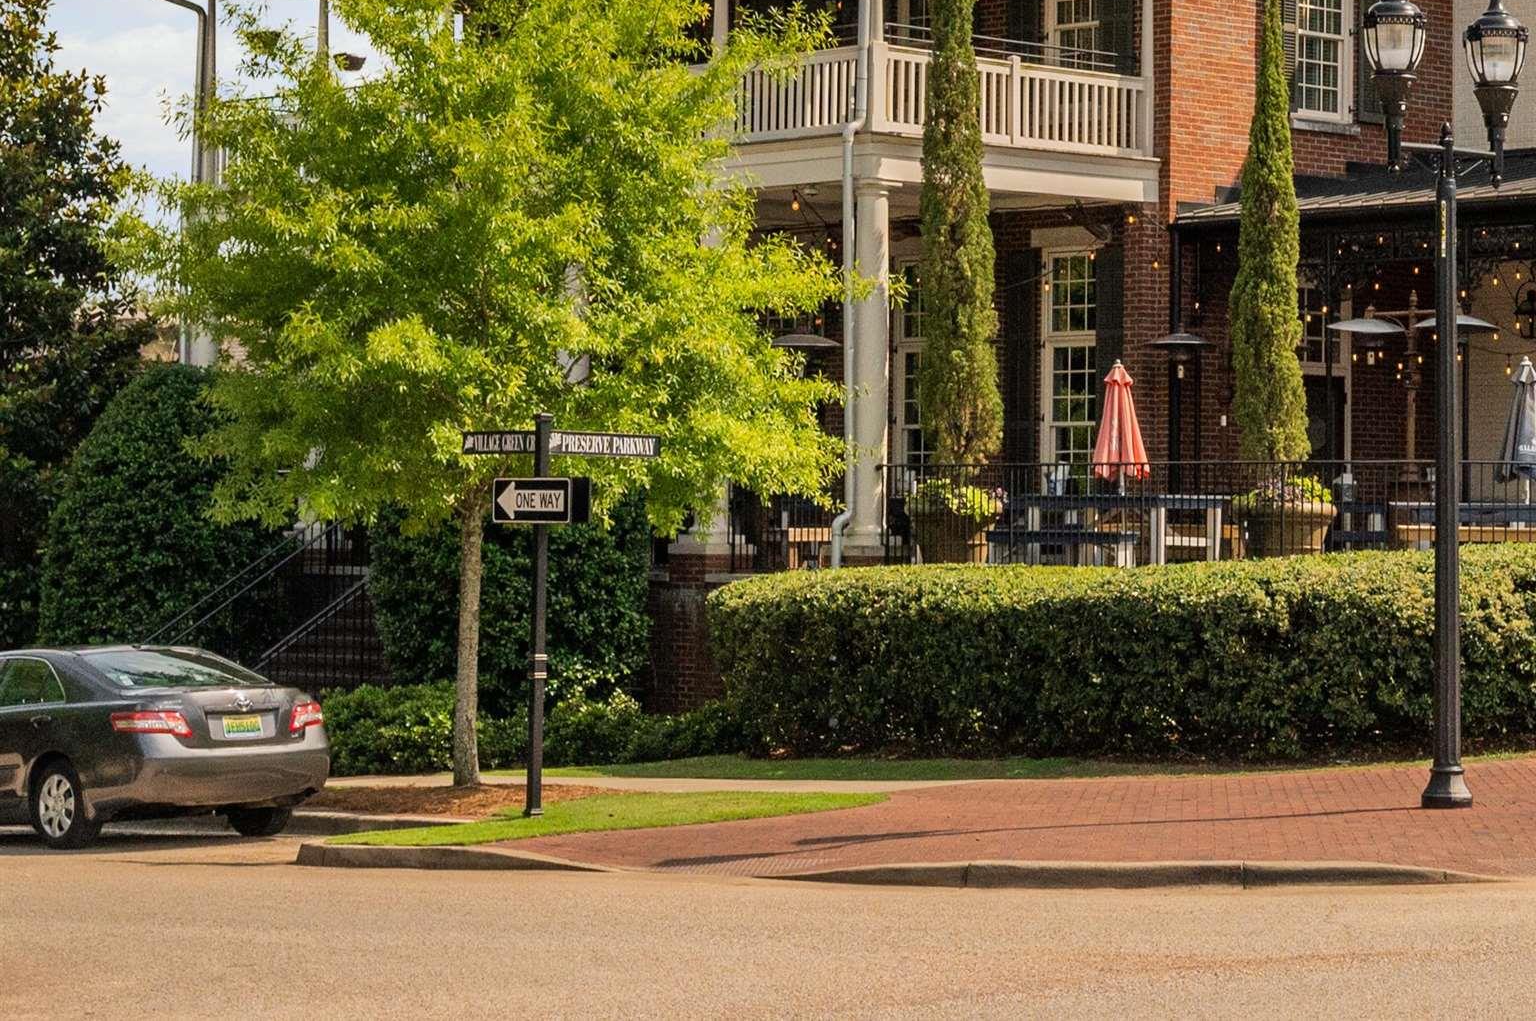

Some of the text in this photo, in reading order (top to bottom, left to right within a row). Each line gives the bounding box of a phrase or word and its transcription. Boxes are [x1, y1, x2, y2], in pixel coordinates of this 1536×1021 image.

[474, 434, 500, 451] VILLAGE
[502, 434, 524, 451] GREEN
[562, 434, 656, 455] PRESERVE PARKWAY
[515, 492, 561, 509] ONE WAY
